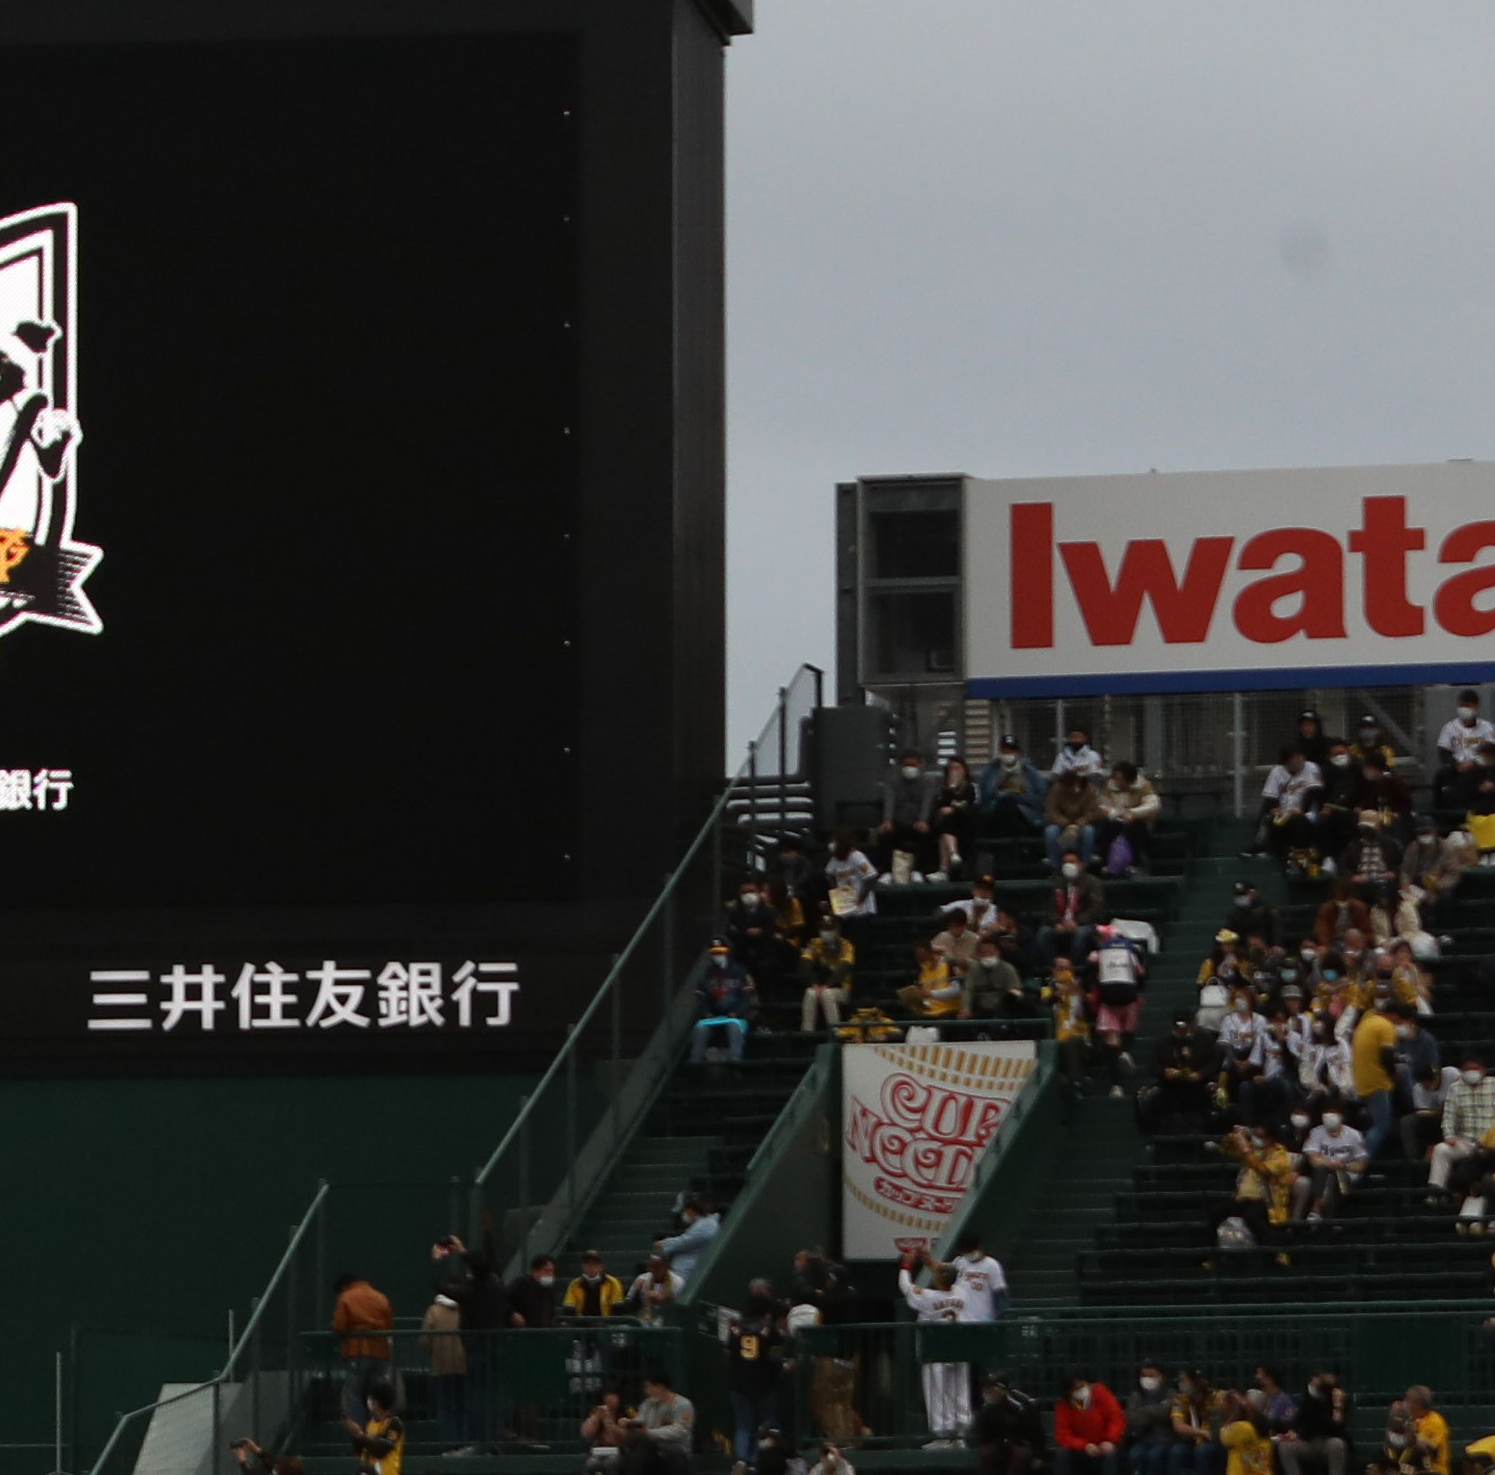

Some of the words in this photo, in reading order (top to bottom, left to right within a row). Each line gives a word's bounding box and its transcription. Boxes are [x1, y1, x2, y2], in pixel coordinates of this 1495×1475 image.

[89, 961, 518, 1029] 三井住友銀行
